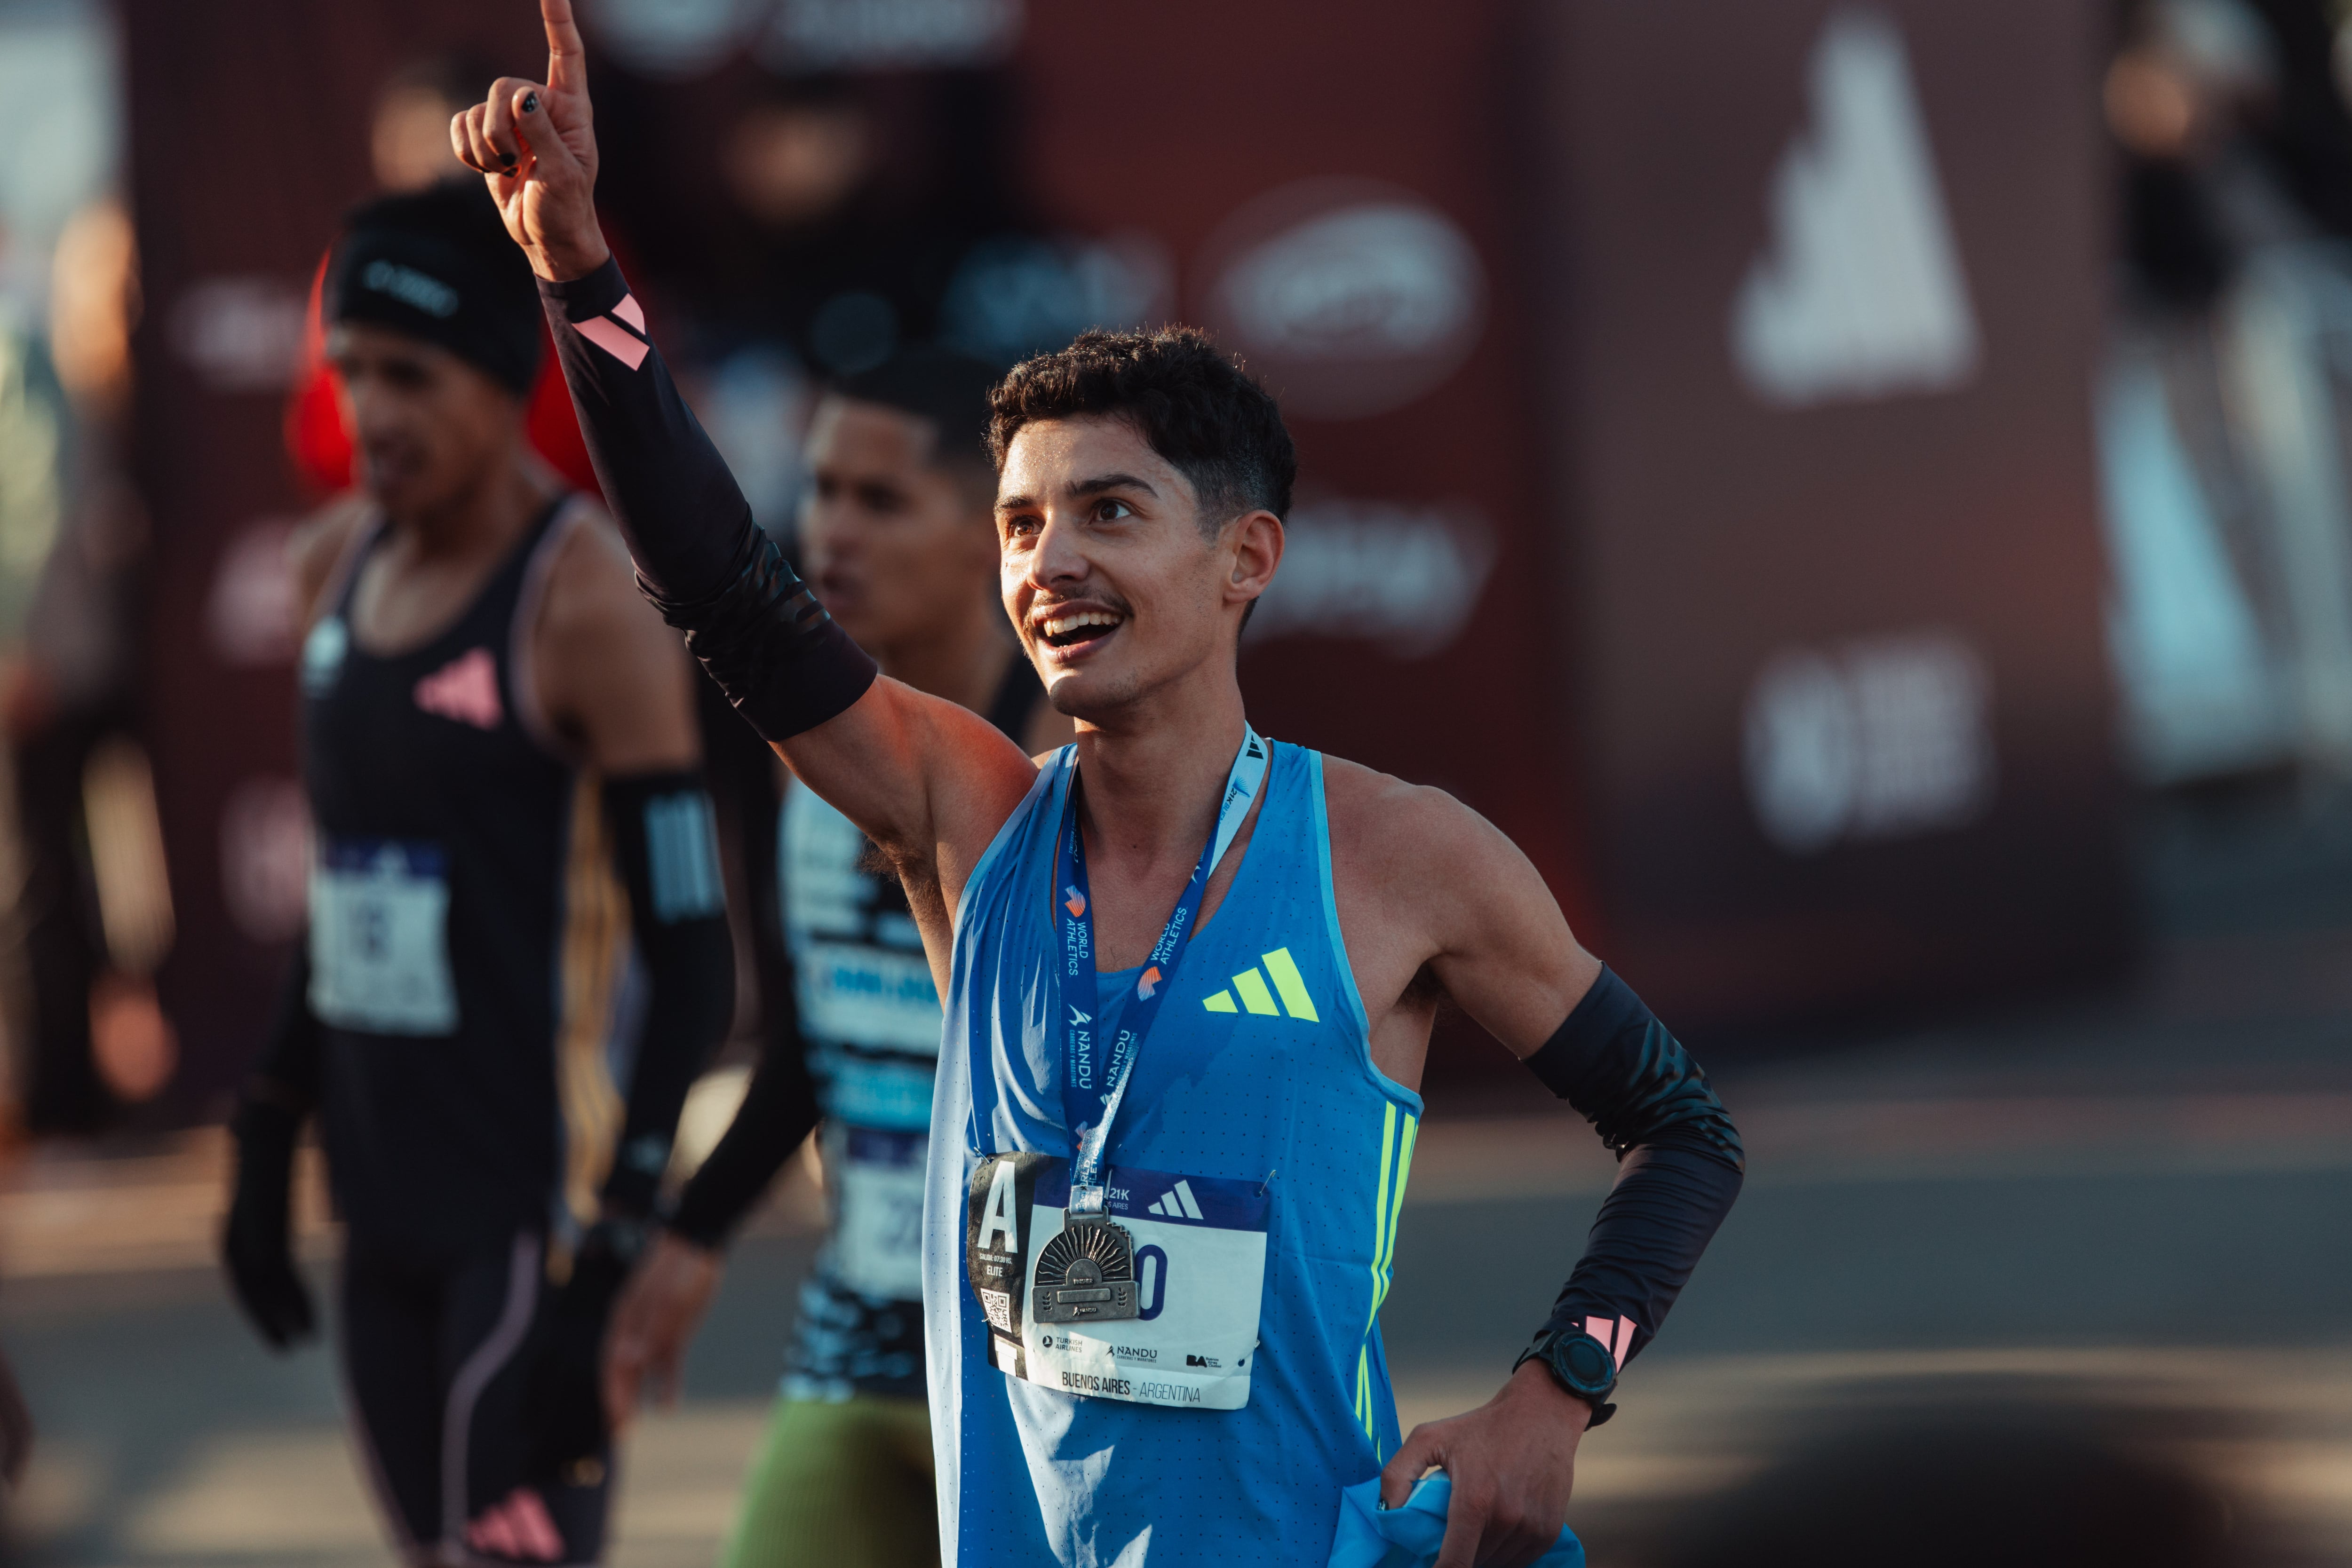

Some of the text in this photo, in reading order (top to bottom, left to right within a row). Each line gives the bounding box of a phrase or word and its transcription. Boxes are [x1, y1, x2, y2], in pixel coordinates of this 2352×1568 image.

[1227, 788, 1238, 805] 21K
[1077, 922, 1089, 958] WORLD
[1151, 923, 1170, 961] WORLD
[1160, 907, 1187, 965] ATHLETICS
[1066, 918, 1079, 976] ATHLETICS
[1109, 1187, 1130, 1201] 21K
[977, 1160, 1018, 1254] A
[1112, 1202, 1129, 1211] AIRES
[993, 1255, 1006, 1264] 07:30
[986, 1265, 1003, 1277] ELITE
[1055, 1344, 1082, 1353] AIRLINES
[1057, 1337, 1083, 1346] TURKISH
[1117, 1346, 1158, 1359] NANDU
[1186, 1354, 1208, 1368] BA
[1062, 1371, 1099, 1391] BUENOS
[1102, 1377, 1130, 1395] AIRES
[1139, 1382, 1200, 1402] ARGENTINA
